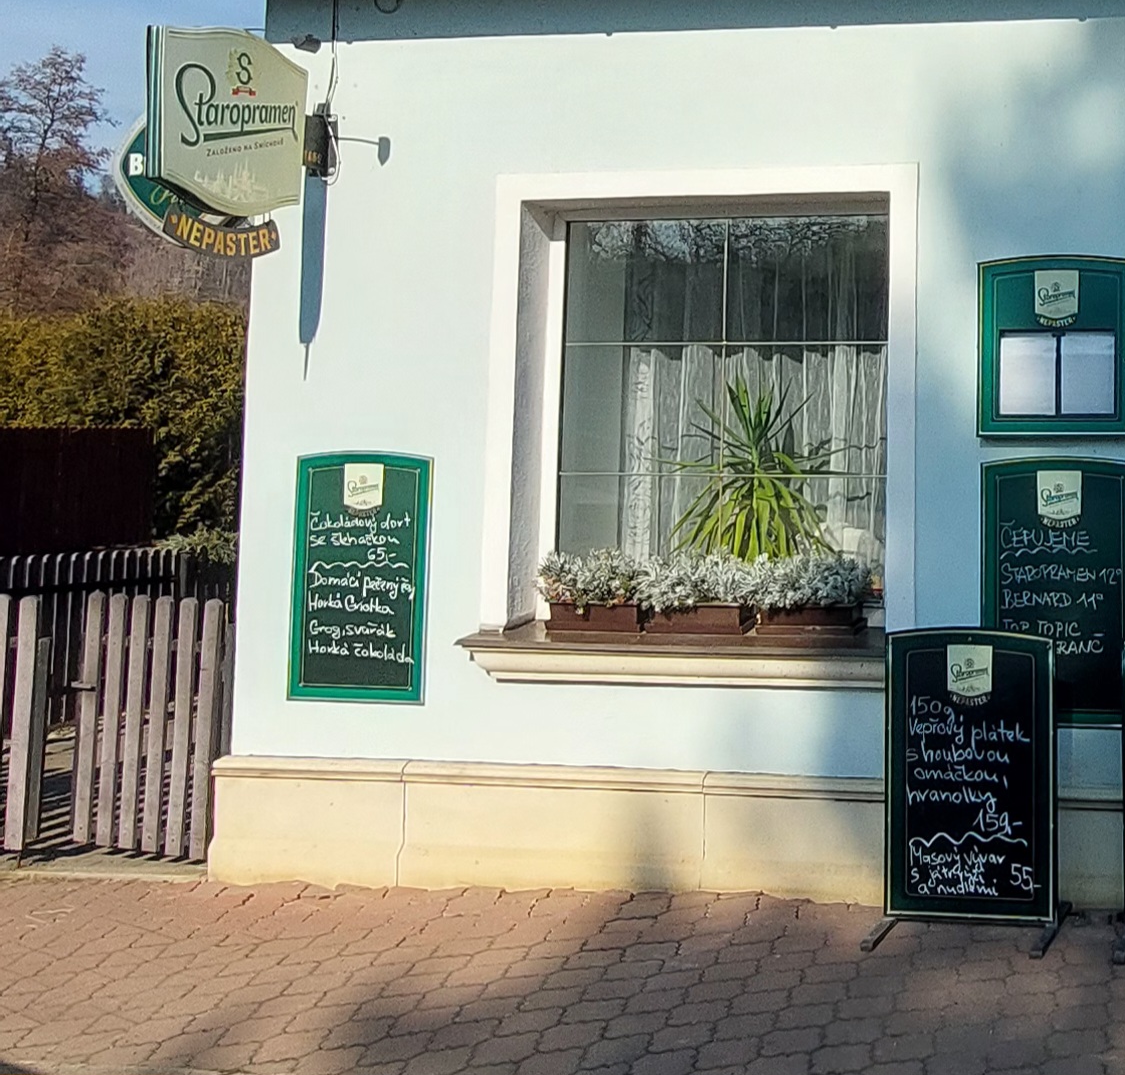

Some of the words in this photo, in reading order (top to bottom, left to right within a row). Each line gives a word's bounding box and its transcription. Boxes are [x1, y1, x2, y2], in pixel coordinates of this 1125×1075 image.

[175, 63, 298, 147] Staropramen
[175, 214, 272, 257] NEPASTER
[310, 510, 377, 534] Čokoládový
[380, 512, 411, 530] dort
[309, 534, 327, 547] se
[1000, 520, 1090, 549] ČEPUJEME
[309, 571, 361, 588] Domácí
[308, 590, 343, 612] Horká
[1001, 588, 1072, 609] BERNARD
[1036, 619, 1081, 638] TOPIC
[308, 639, 349, 655] Horká
[352, 641, 415, 664] čokoláda
[971, 720, 1031, 746] plátek
[906, 783, 997, 813] hranolky
